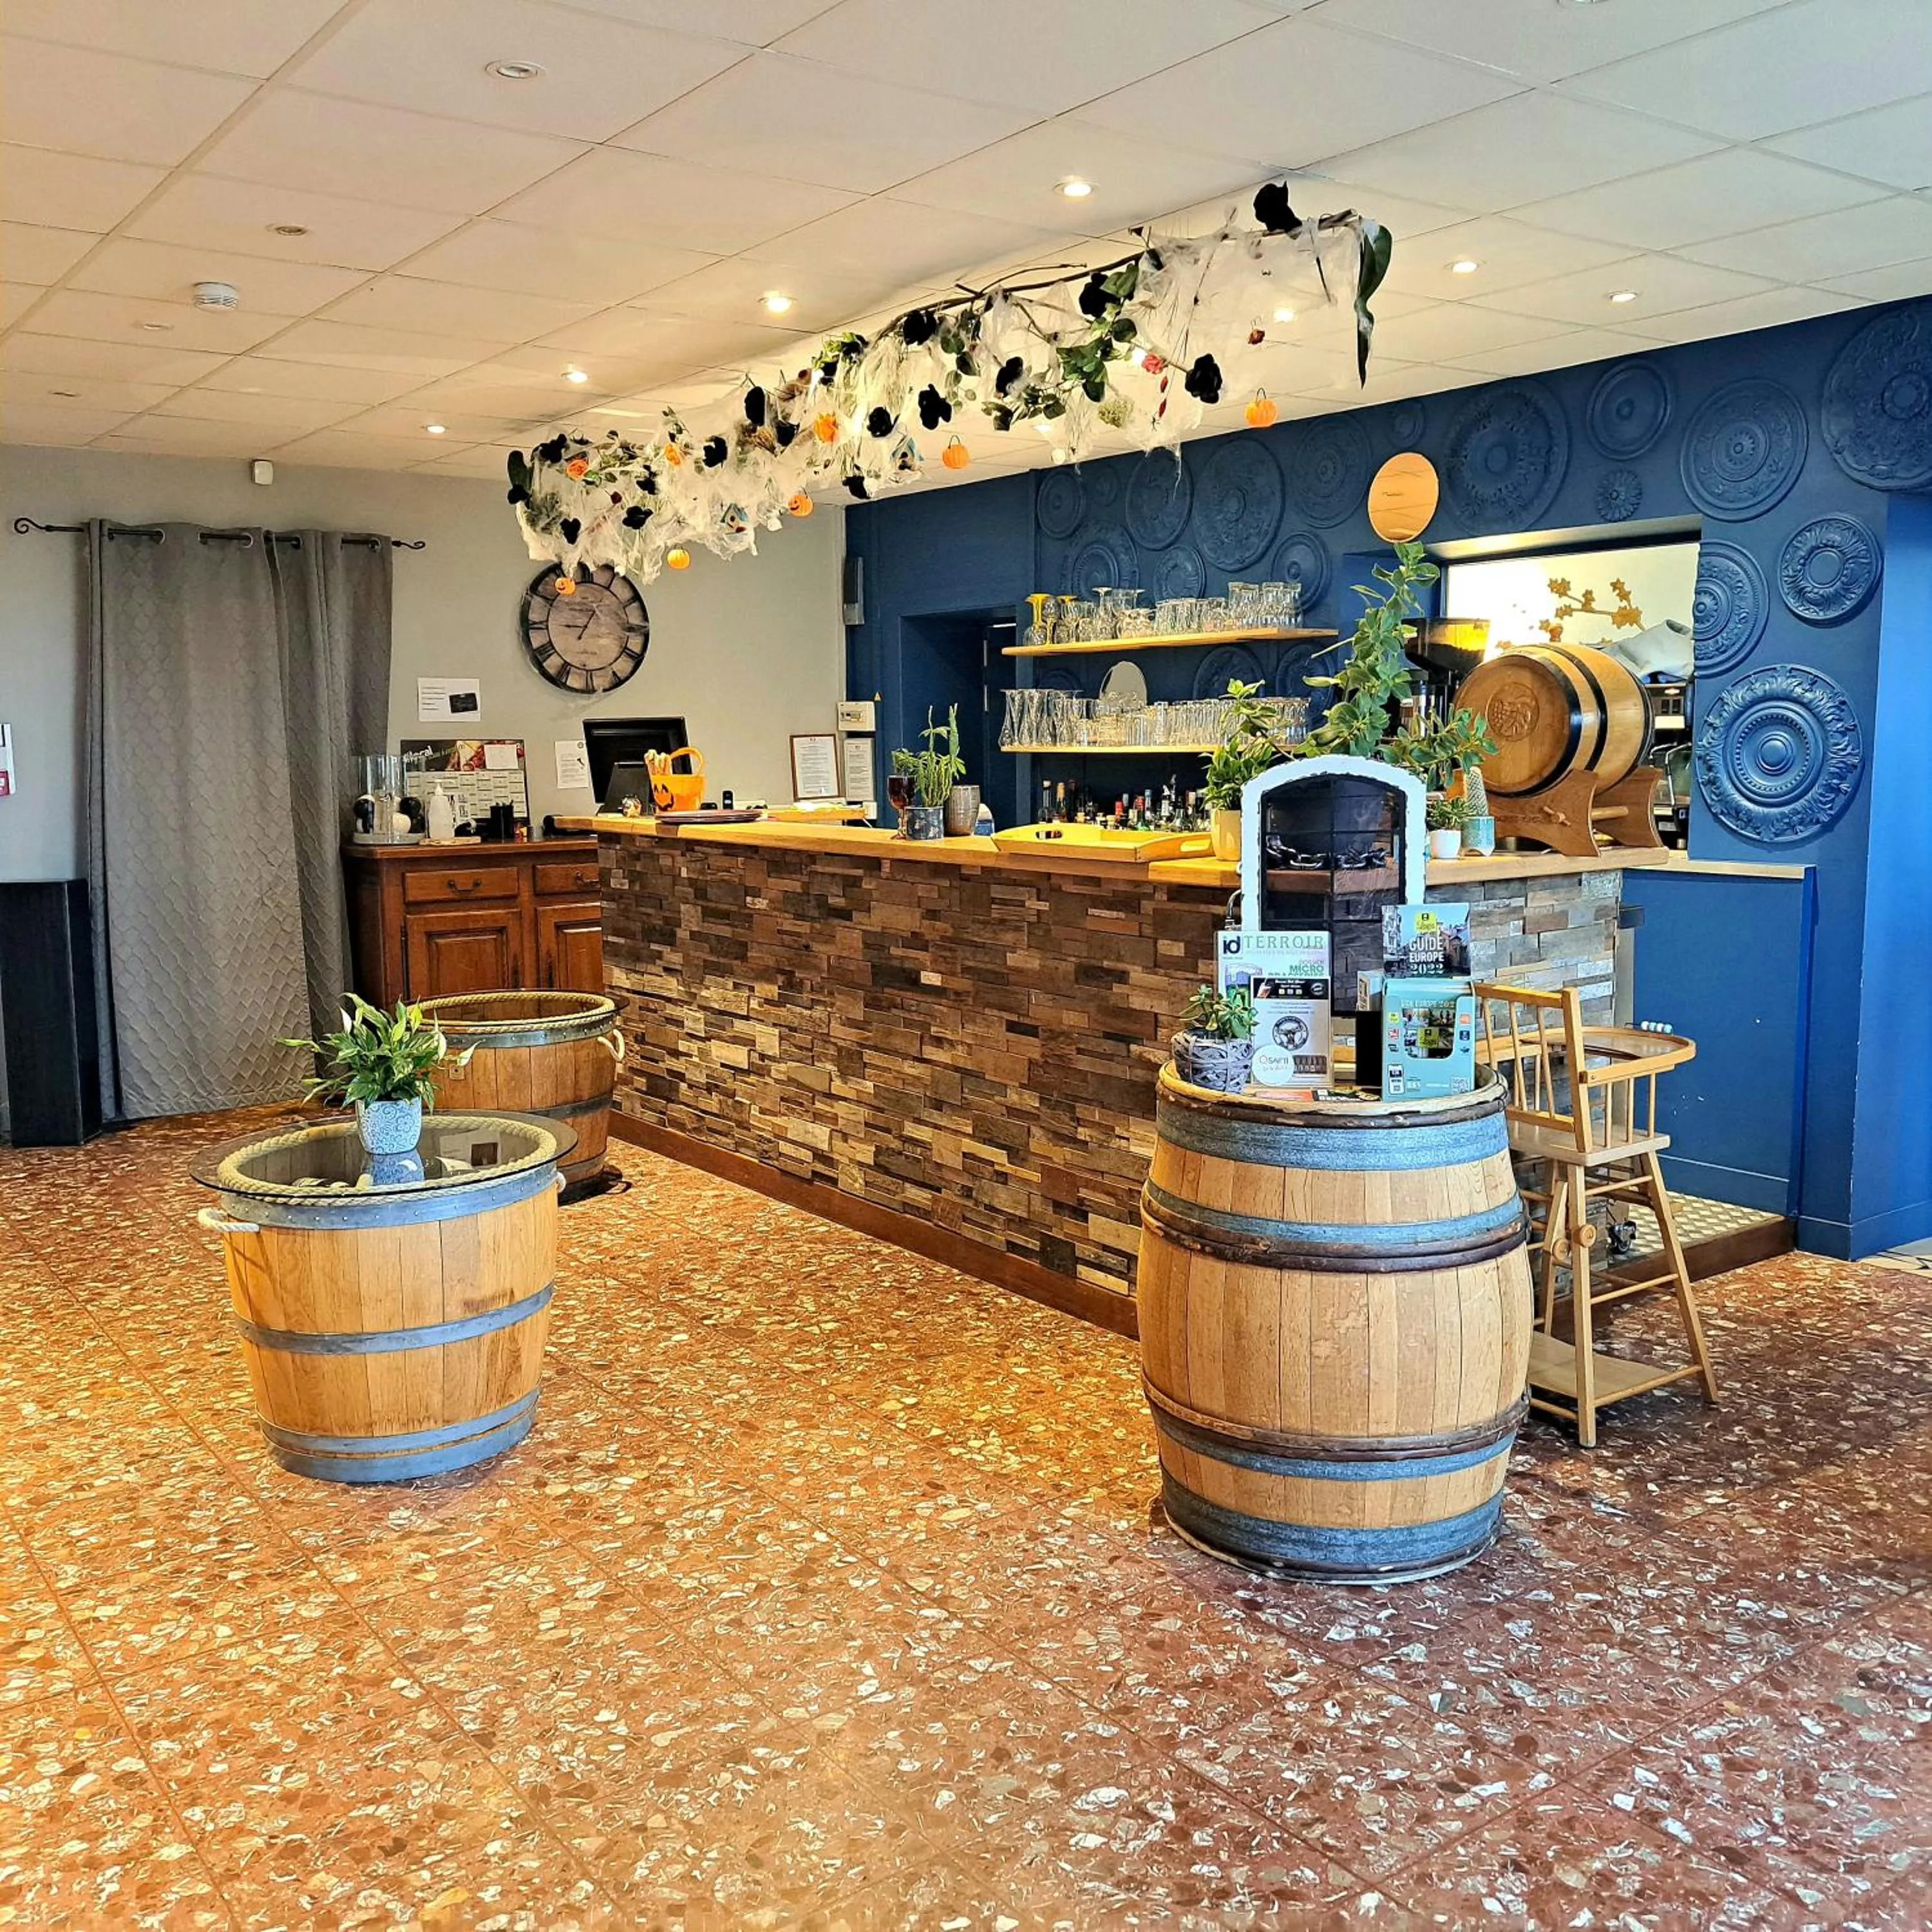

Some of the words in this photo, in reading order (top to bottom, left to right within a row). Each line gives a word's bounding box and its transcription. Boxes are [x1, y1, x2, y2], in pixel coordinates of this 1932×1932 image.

[1244, 935, 1325, 949] TERROIR
[1409, 936, 1444, 951] GUIDE
[1409, 951, 1445, 963] EUROPE
[1409, 963, 1444, 974] 2022
